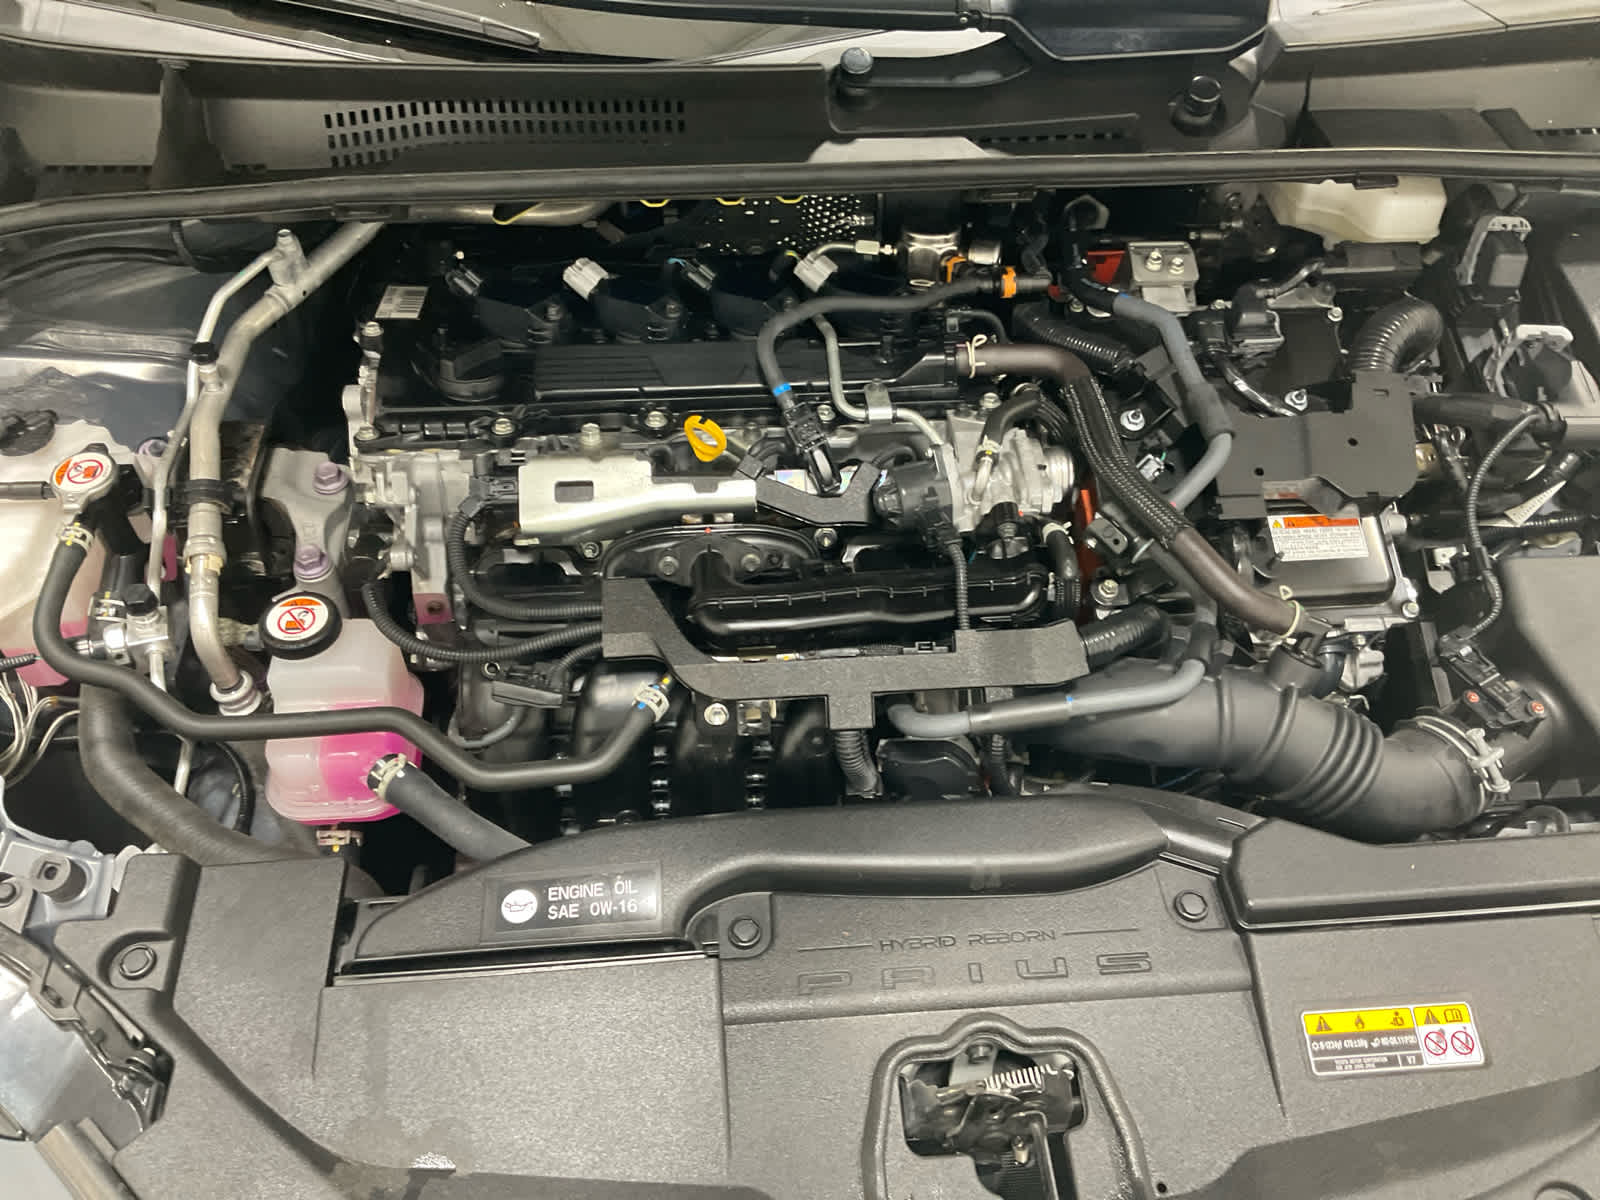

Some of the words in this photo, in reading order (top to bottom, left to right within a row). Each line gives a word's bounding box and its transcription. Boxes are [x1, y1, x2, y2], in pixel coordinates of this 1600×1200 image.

[547, 883, 604, 902] ENGINE
[614, 879, 639, 895] OIL
[547, 904, 580, 920] SAE
[590, 899, 638, 916] 0W-16
[879, 935, 957, 952] HYBRID
[967, 929, 1057, 947] REBORN
[796, 951, 1153, 997] PRIUS
